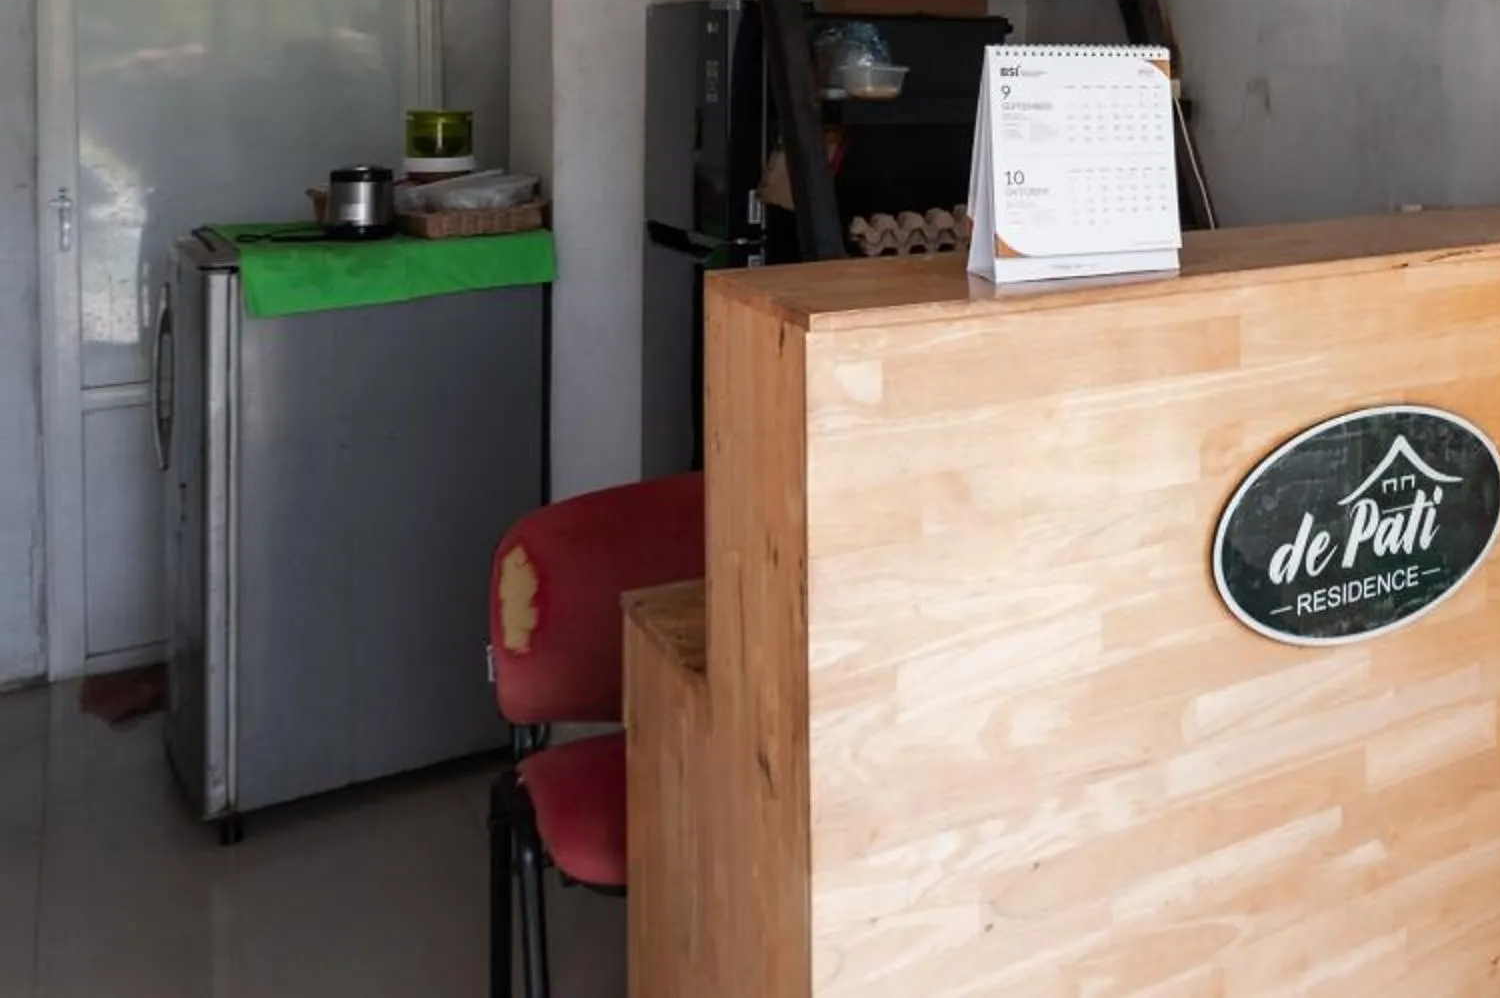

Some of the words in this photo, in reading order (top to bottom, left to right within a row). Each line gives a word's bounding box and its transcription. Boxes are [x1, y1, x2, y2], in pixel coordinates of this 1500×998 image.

[1001, 85, 1011, 100] 9
[1005, 169, 1025, 186] 10
[1269, 512, 1338, 585] de
[1341, 485, 1443, 569] Pati
[1296, 566, 1419, 616] RESIDENCE
